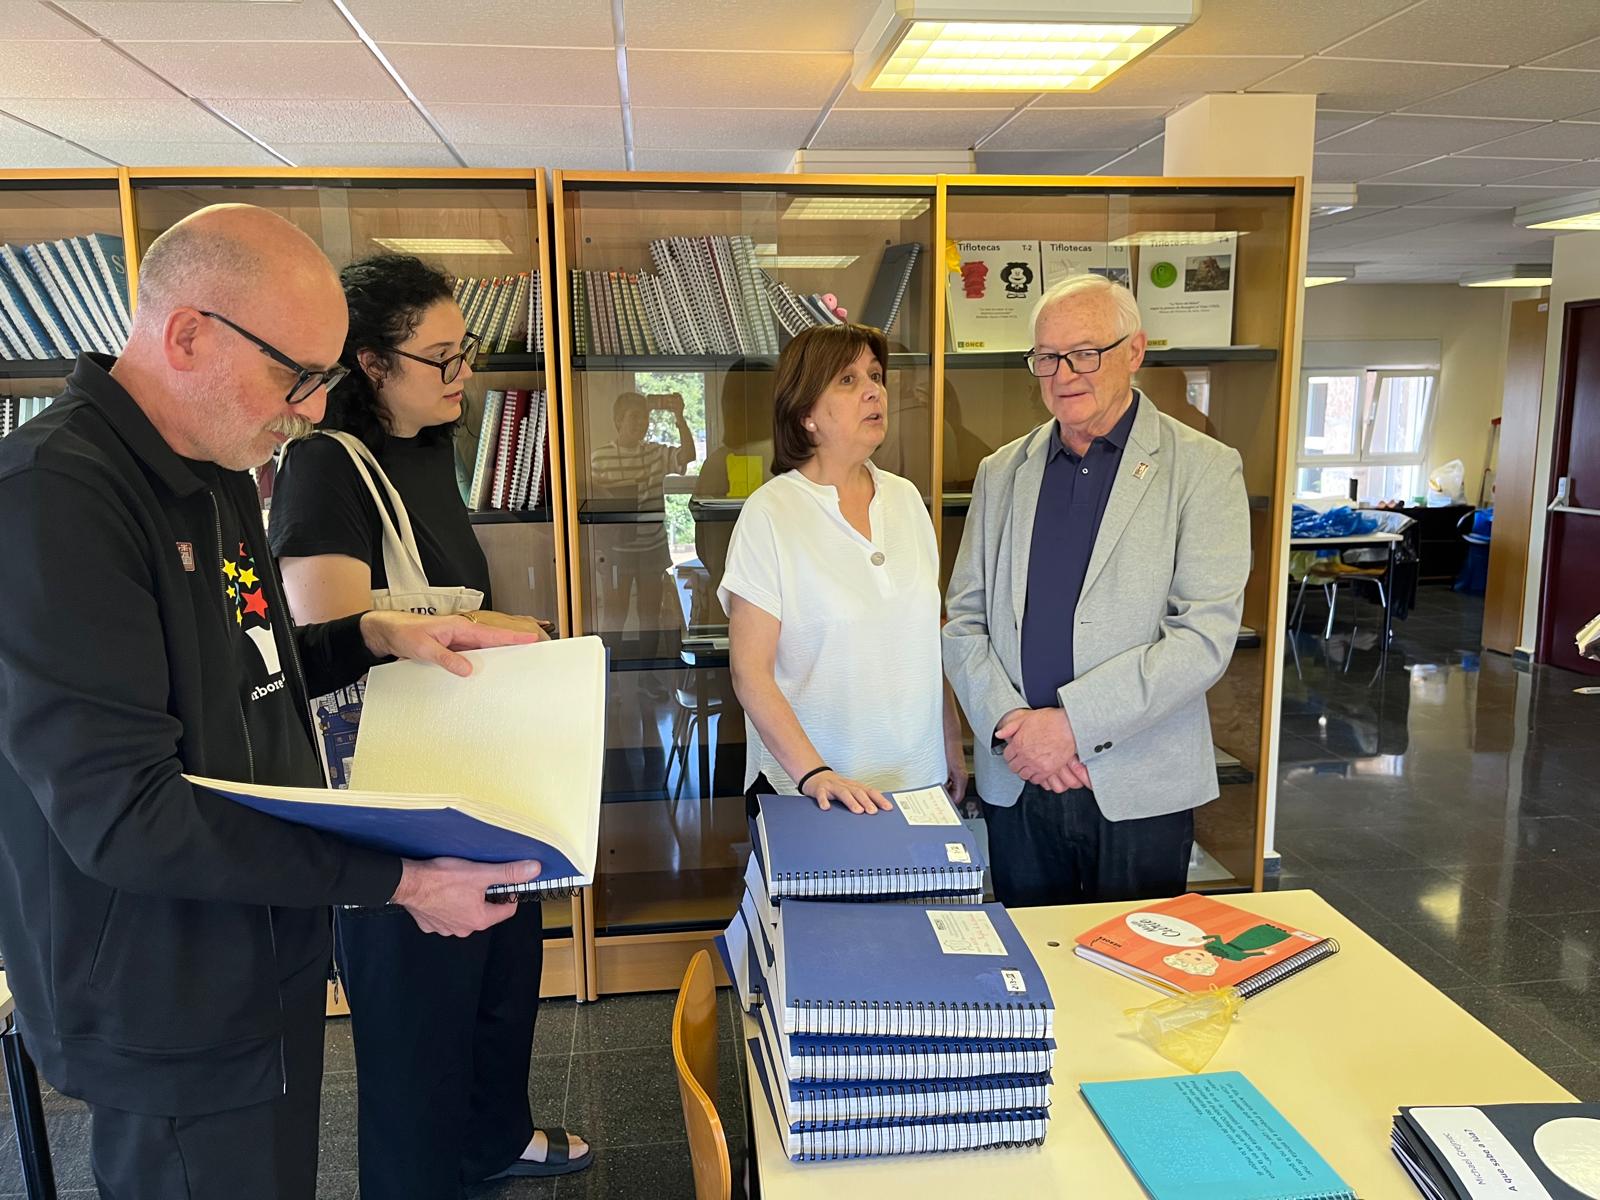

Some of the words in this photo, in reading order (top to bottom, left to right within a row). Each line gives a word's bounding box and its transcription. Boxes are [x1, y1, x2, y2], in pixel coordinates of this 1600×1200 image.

[957, 242, 1000, 252] Tiflotecas
[1050, 243, 1092, 252] Tiflotecas
[1483, 1149, 1500, 1167] sabe
[1497, 1168, 1513, 1184] que
